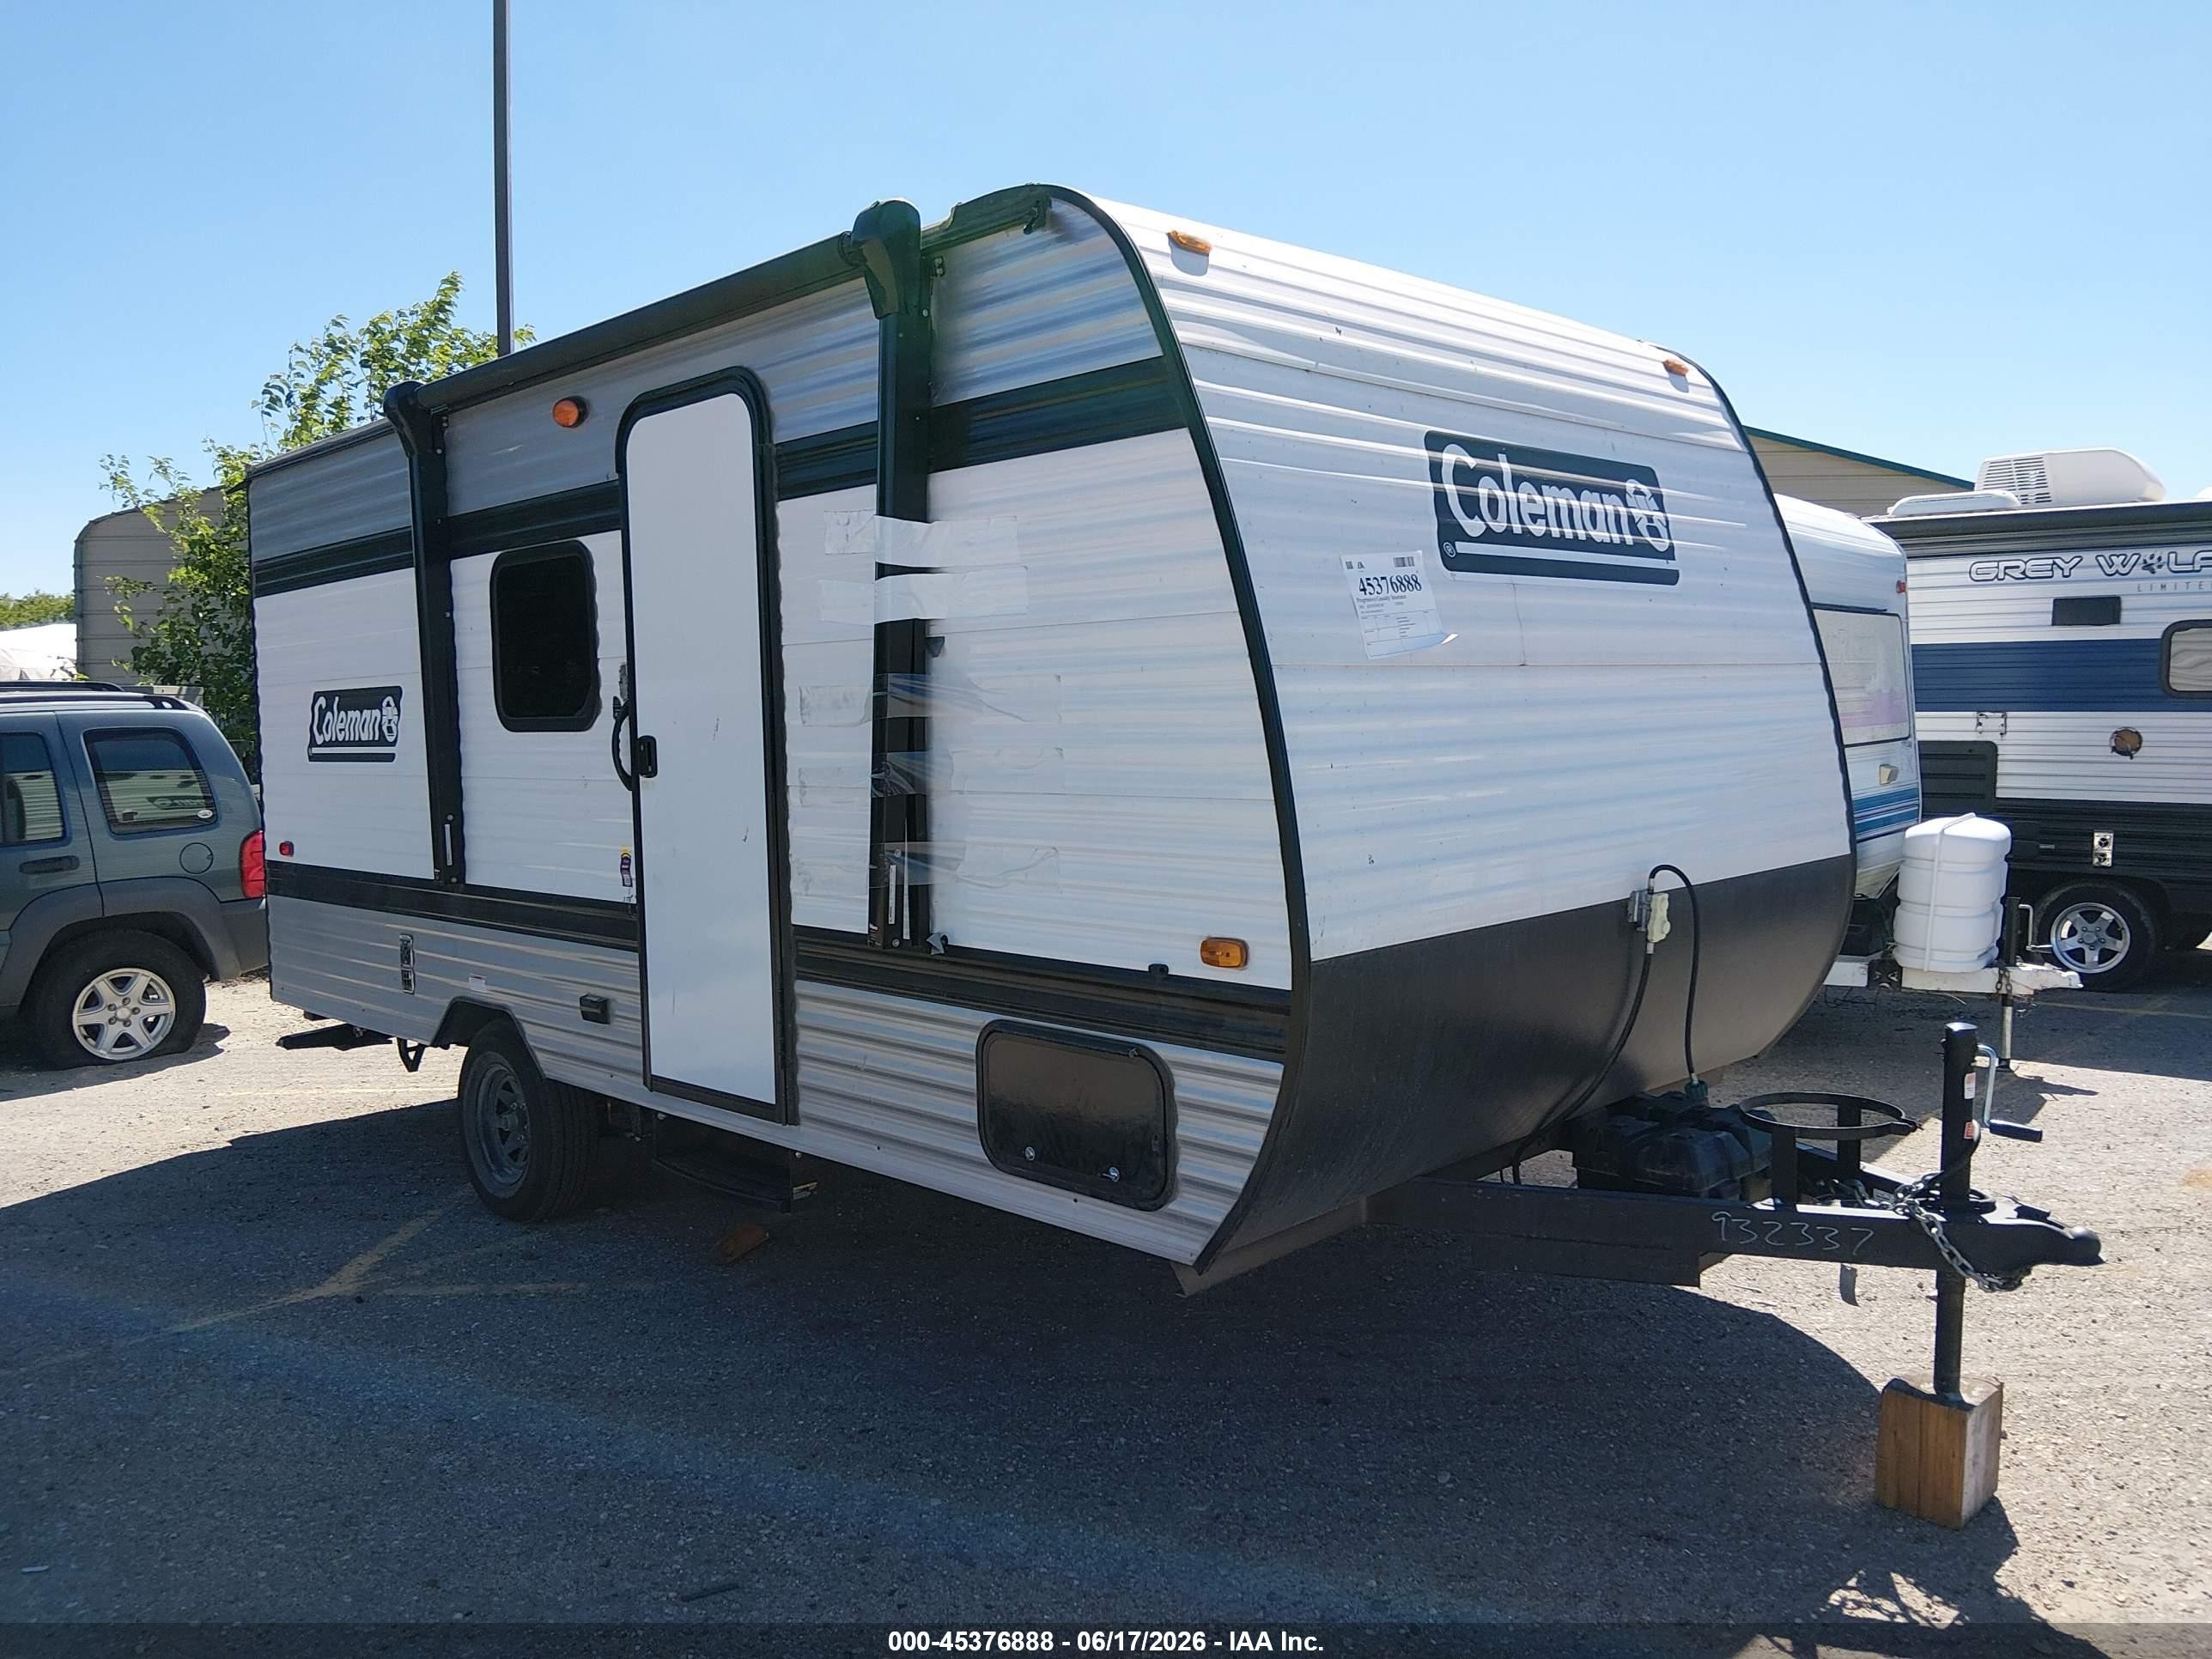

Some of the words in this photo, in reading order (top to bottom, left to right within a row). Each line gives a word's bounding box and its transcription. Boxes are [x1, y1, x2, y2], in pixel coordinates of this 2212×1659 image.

[1442, 443, 1634, 546] Coleman
[1358, 574, 1422, 595] 45376888
[1969, 556, 2082, 582] GREY
[2137, 580, 2212, 592] LIMITE
[313, 696, 381, 745] Coleman
[1711, 1211, 1874, 1255] 932337
